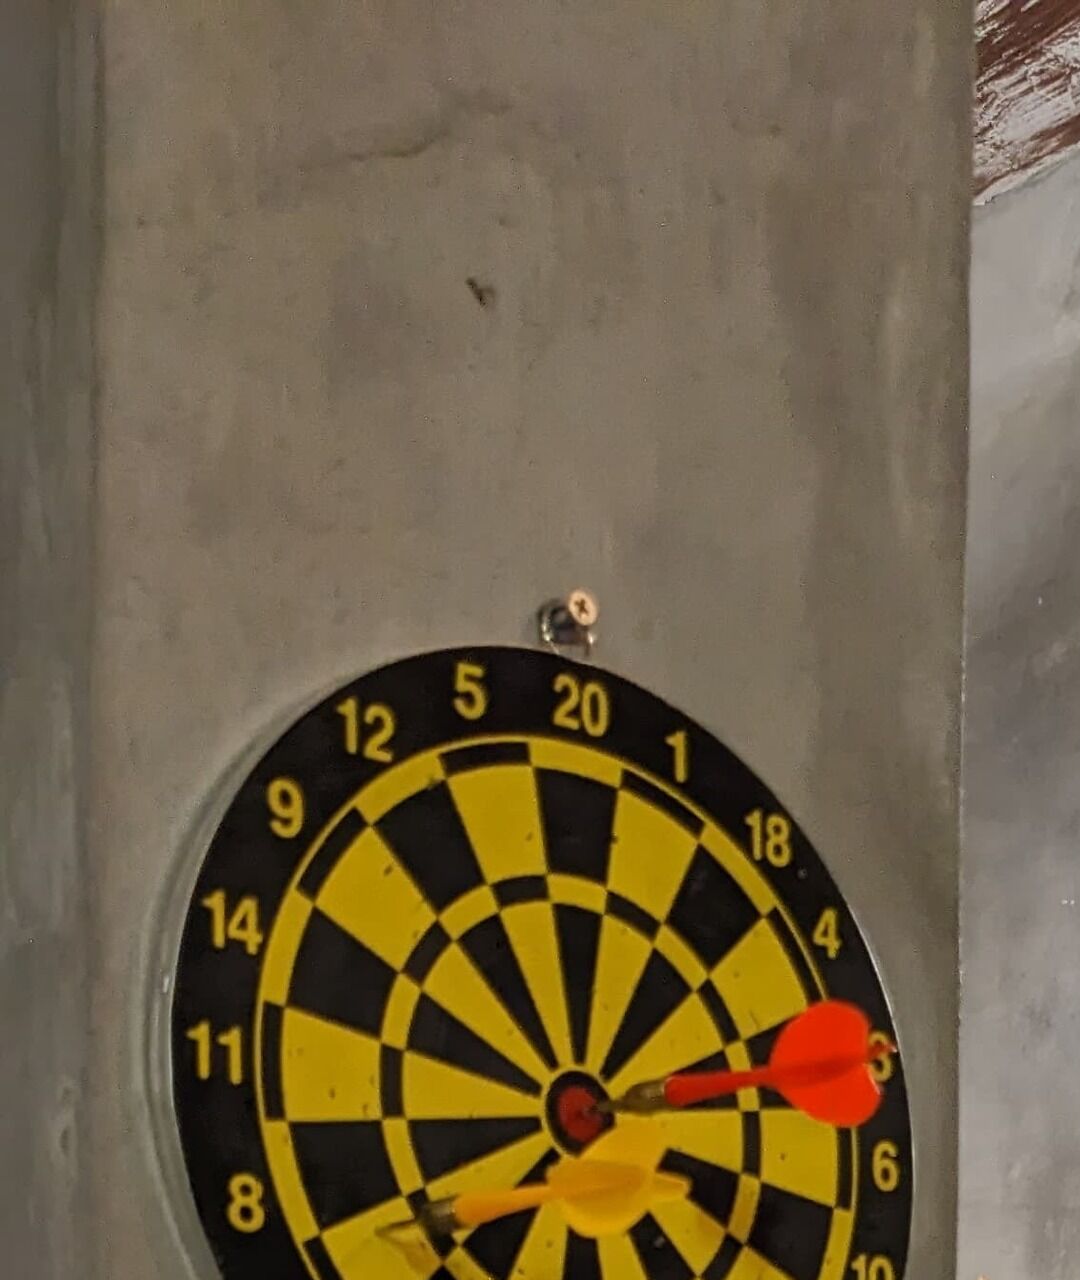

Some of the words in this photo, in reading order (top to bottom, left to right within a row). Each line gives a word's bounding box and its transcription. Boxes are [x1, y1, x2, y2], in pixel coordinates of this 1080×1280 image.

[454, 662, 486, 720] 5
[553, 674, 609, 737] 20
[337, 698, 395, 763] 12
[666, 731, 688, 783] 1
[267, 778, 304, 838] 9
[745, 810, 791, 868] 18
[202, 890, 264, 956] 14
[813, 908, 842, 959] 4
[187, 1021, 243, 1085] 11
[871, 1140, 899, 1192] 6
[228, 1173, 265, 1233] 8
